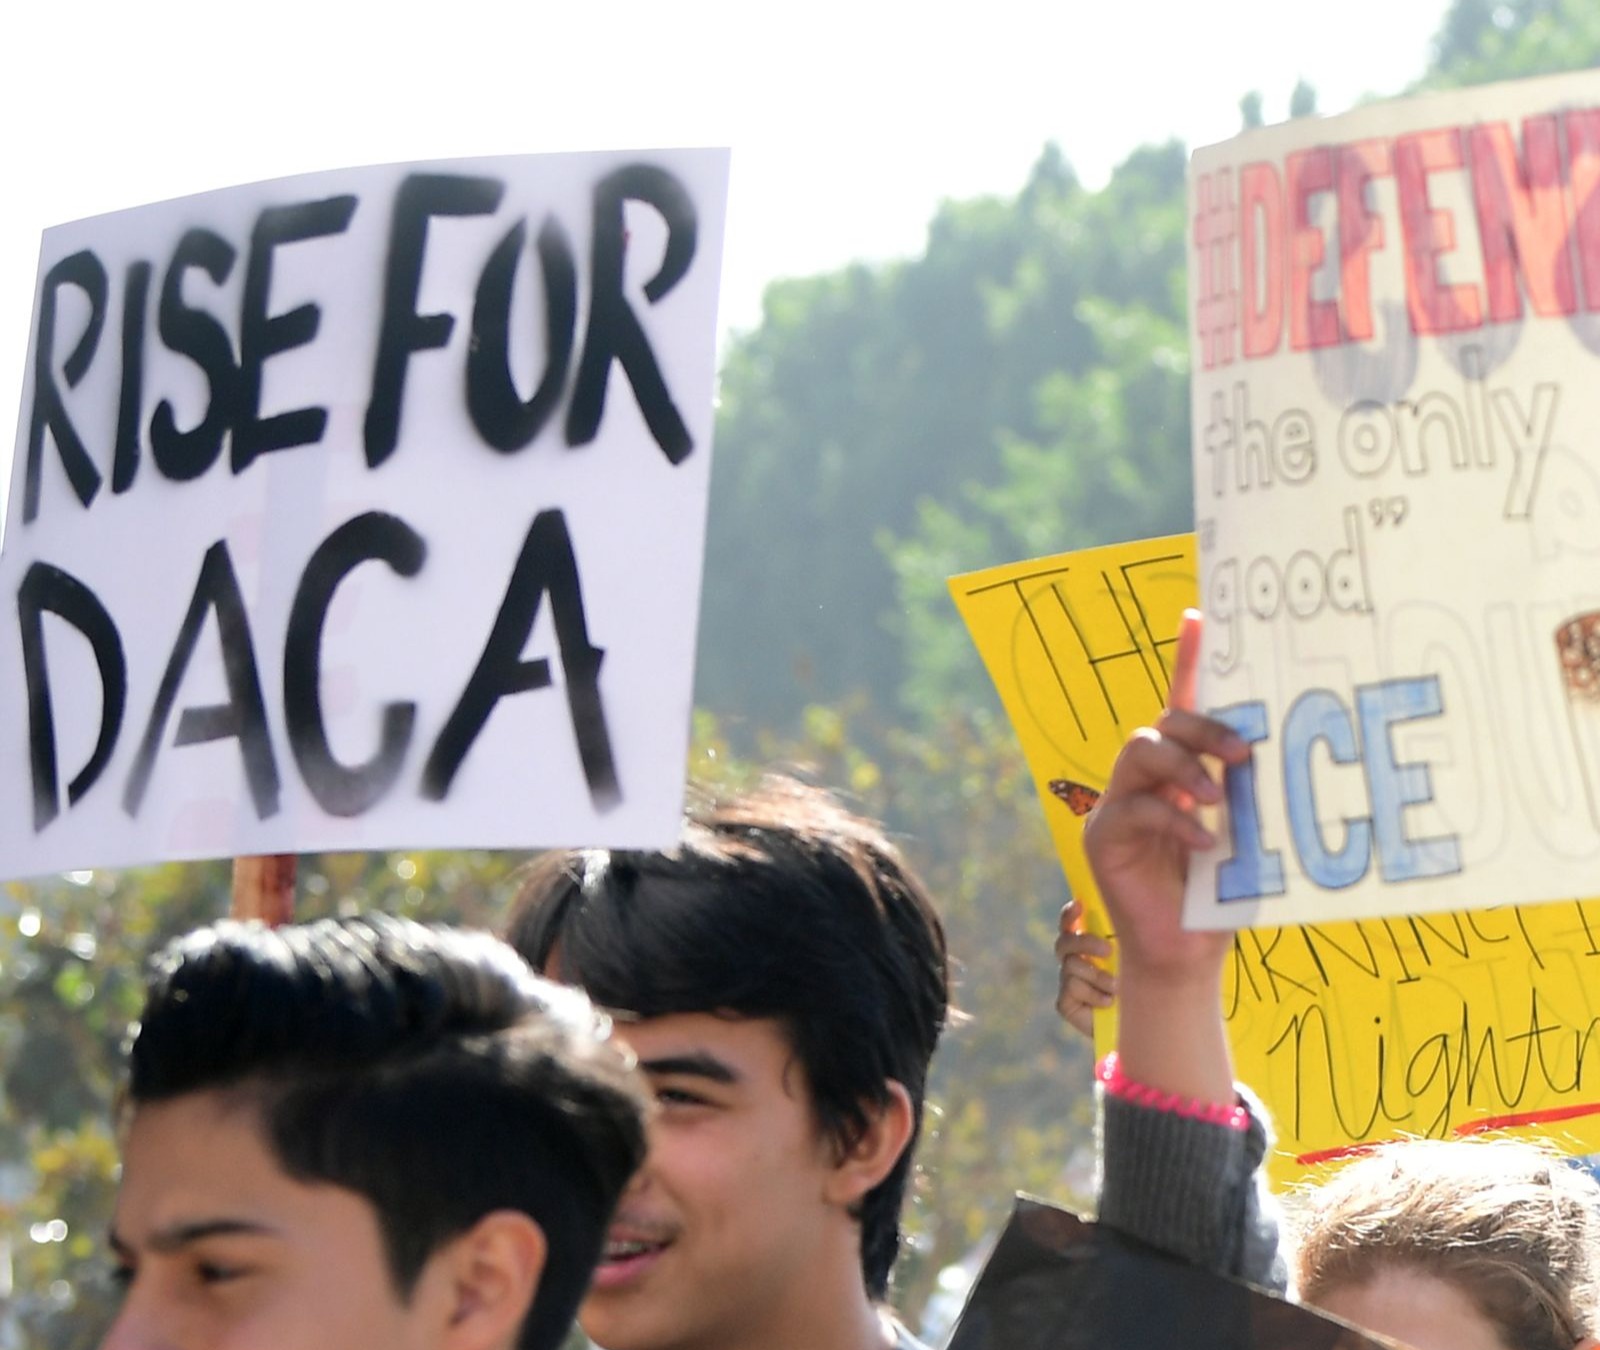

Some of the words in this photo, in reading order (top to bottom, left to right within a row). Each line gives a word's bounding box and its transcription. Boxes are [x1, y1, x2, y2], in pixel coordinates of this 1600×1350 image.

[22, 194, 359, 525] RISE
[364, 163, 699, 470] FOR
[1204, 378, 1318, 500] the
[1337, 343, 1562, 521] only
[17, 508, 624, 832] DACA
[1215, 672, 1463, 905] ICE
